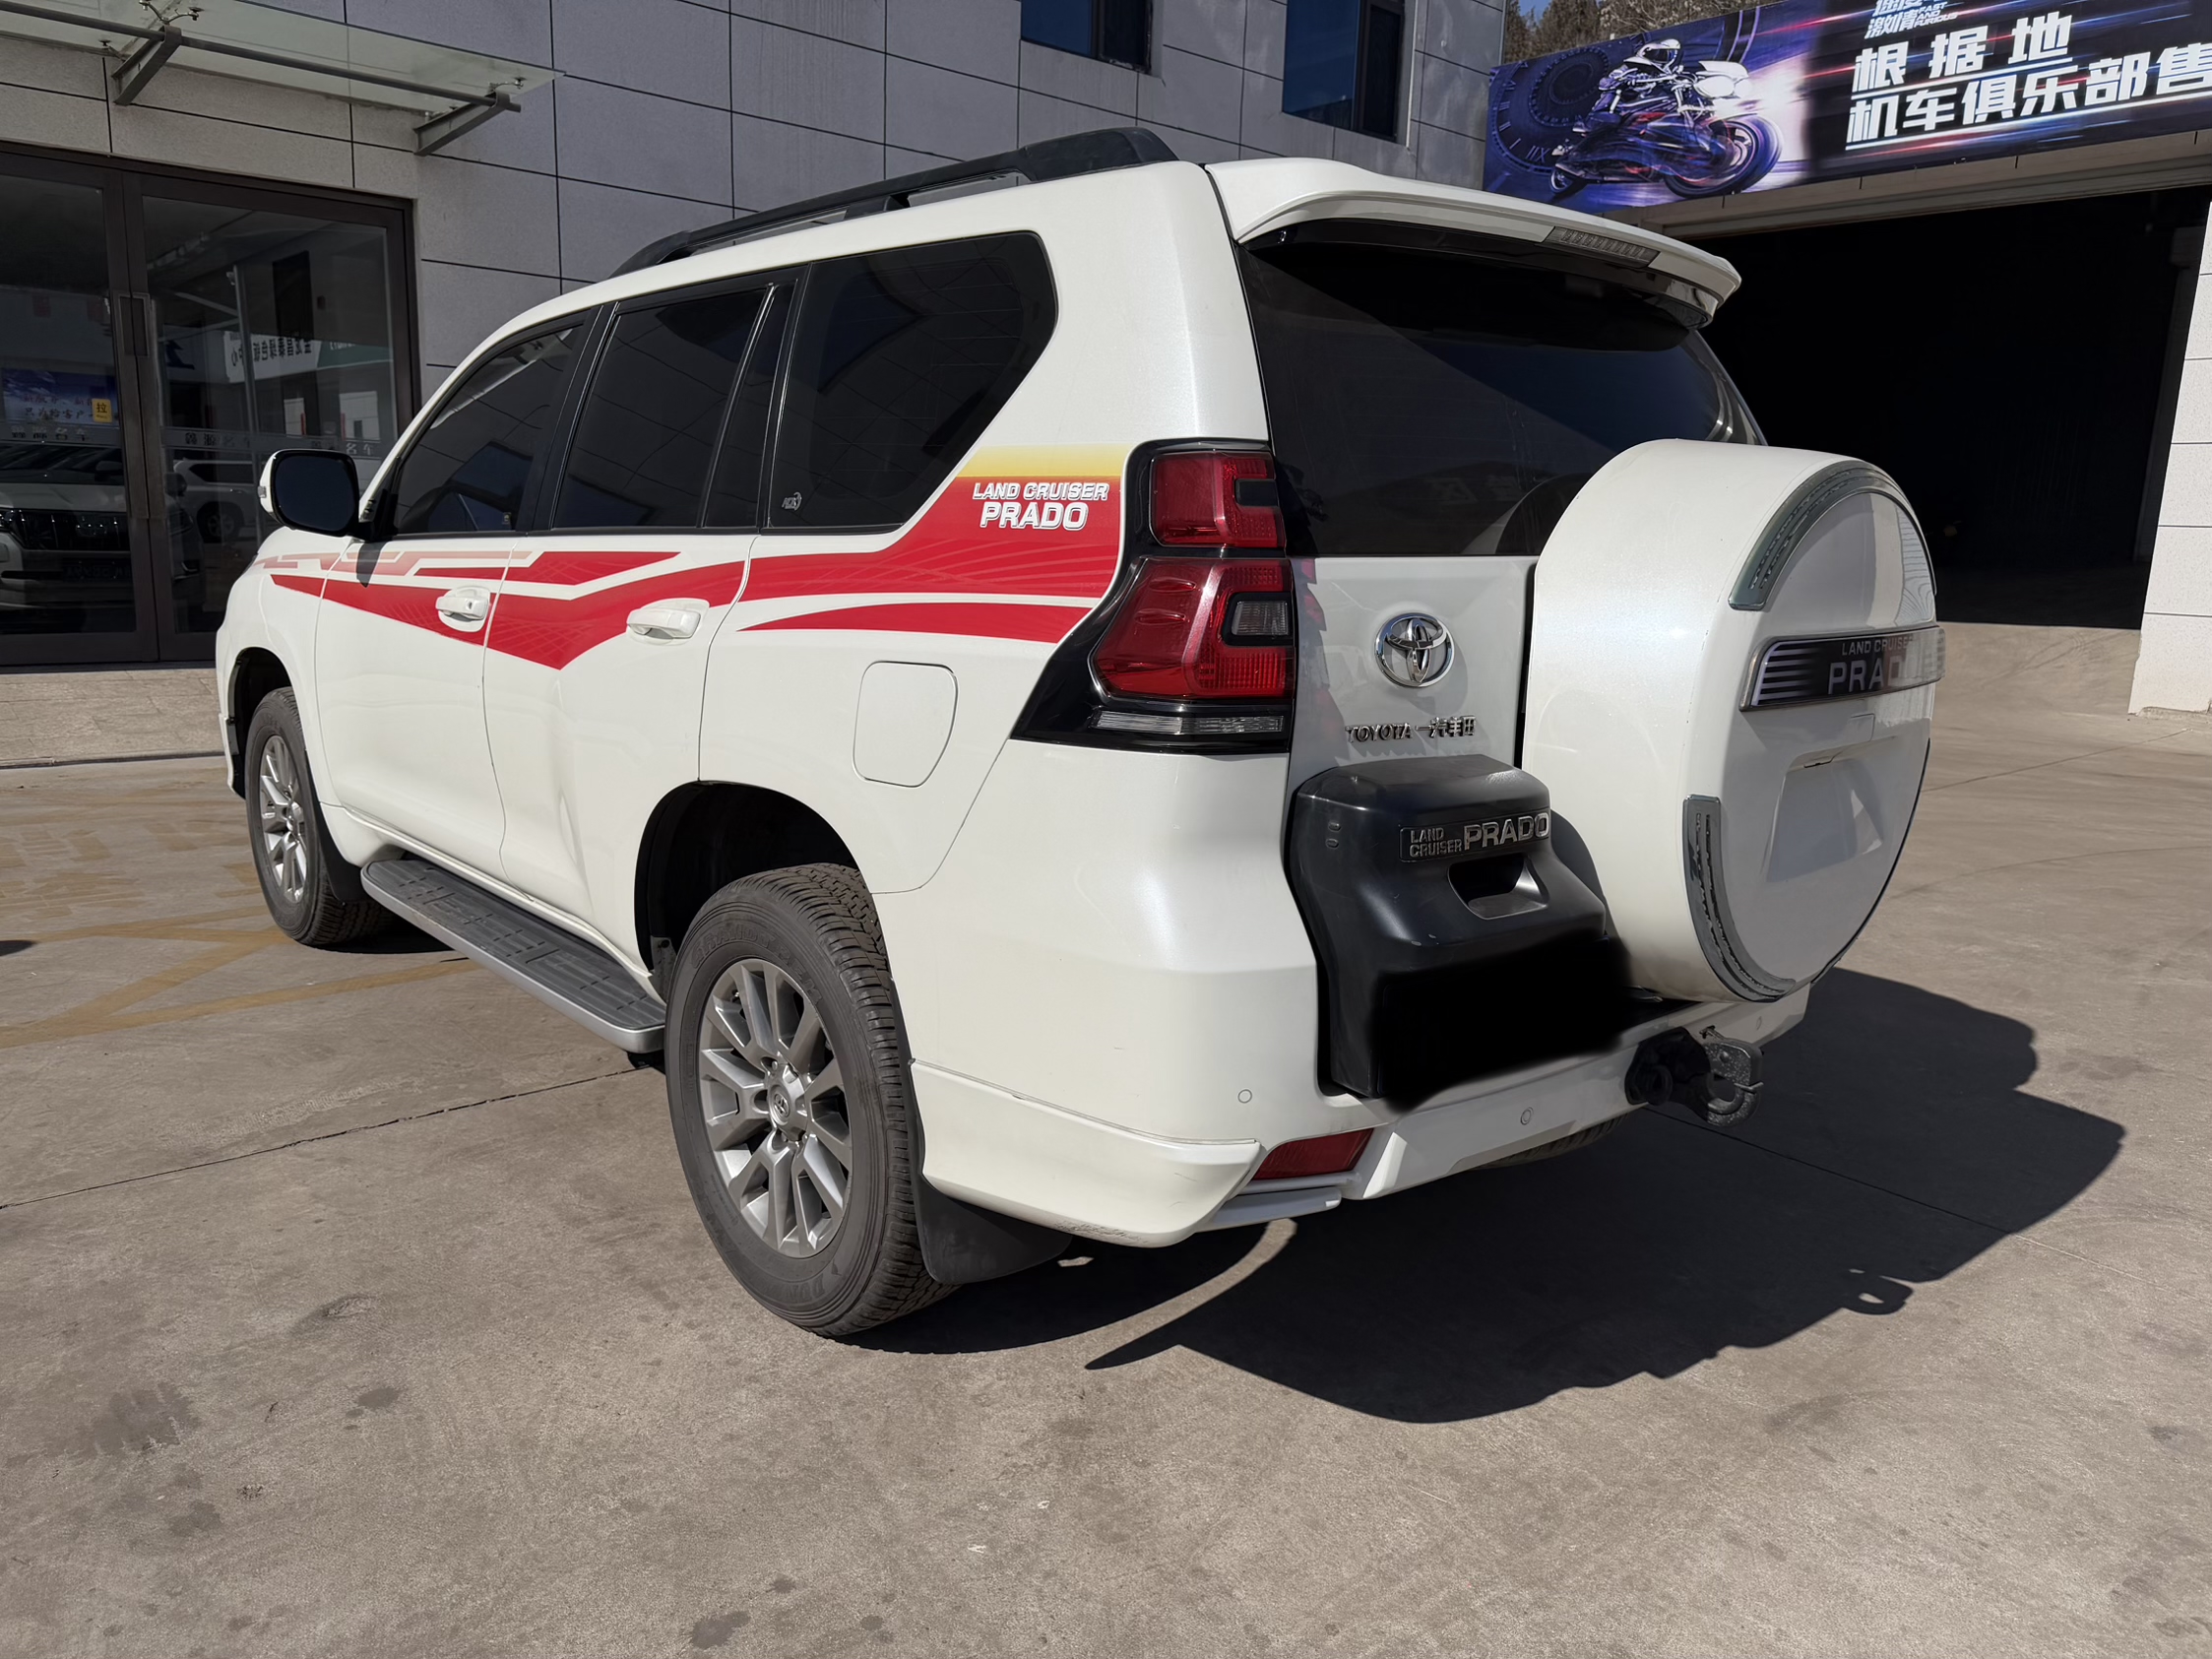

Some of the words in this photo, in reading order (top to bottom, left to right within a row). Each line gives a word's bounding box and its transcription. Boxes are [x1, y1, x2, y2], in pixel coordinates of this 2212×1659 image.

[1864, 9, 1919, 39] 激情
[1917, 10, 1940, 21] AND
[1852, 11, 2073, 93] 根据地
[1846, 42, 2212, 144] 机车俱乐部售
[96, 403, 107, 414] 拉
[973, 482, 1021, 500] LAND
[1023, 482, 1109, 501] CRUISER
[980, 501, 1089, 531] PRADO
[1842, 640, 1870, 656] LAND
[1828, 656, 1905, 695] PRAD
[1345, 723, 1413, 743] TOYOTA
[1415, 716, 1476, 738] 一汽丰田
[1410, 827, 1445, 844] LAND
[1464, 812, 1549, 851] PRADO
[1409, 838, 1462, 858] CRUISER
